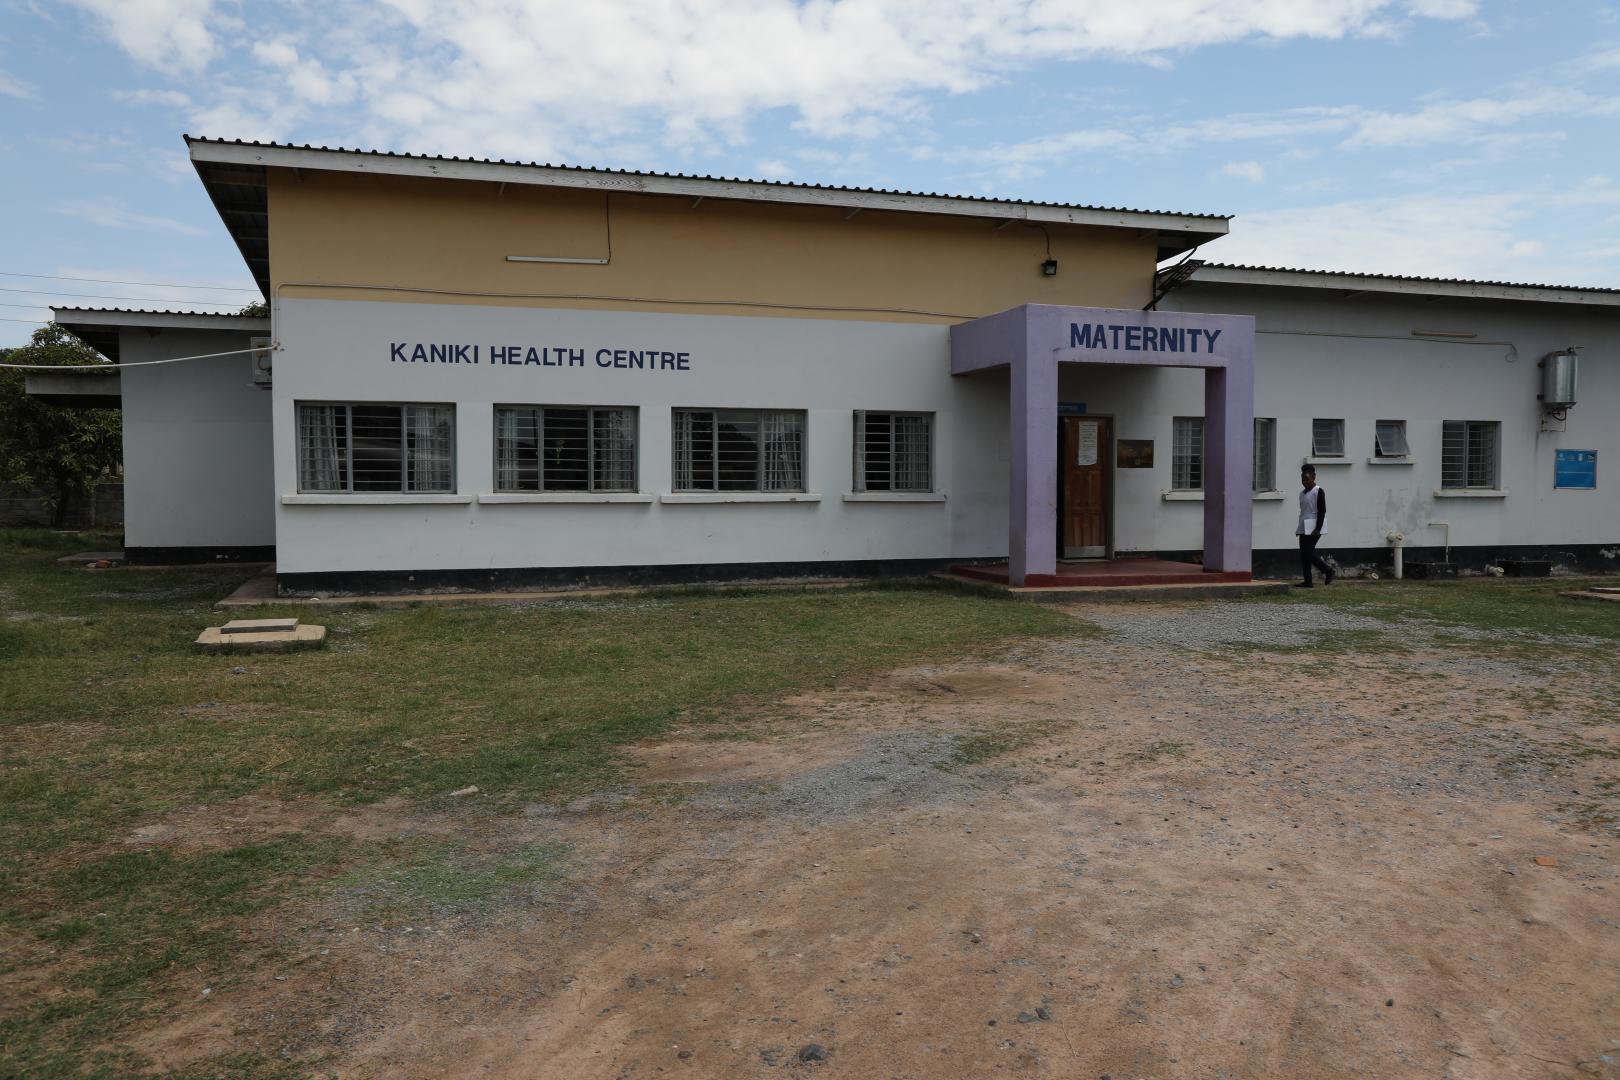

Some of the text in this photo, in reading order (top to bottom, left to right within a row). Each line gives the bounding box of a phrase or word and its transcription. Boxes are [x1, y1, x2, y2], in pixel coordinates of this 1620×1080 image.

[1070, 323, 1222, 353] MATERNITY
[390, 343, 690, 370] KANIKI HEALTH CENTRE
